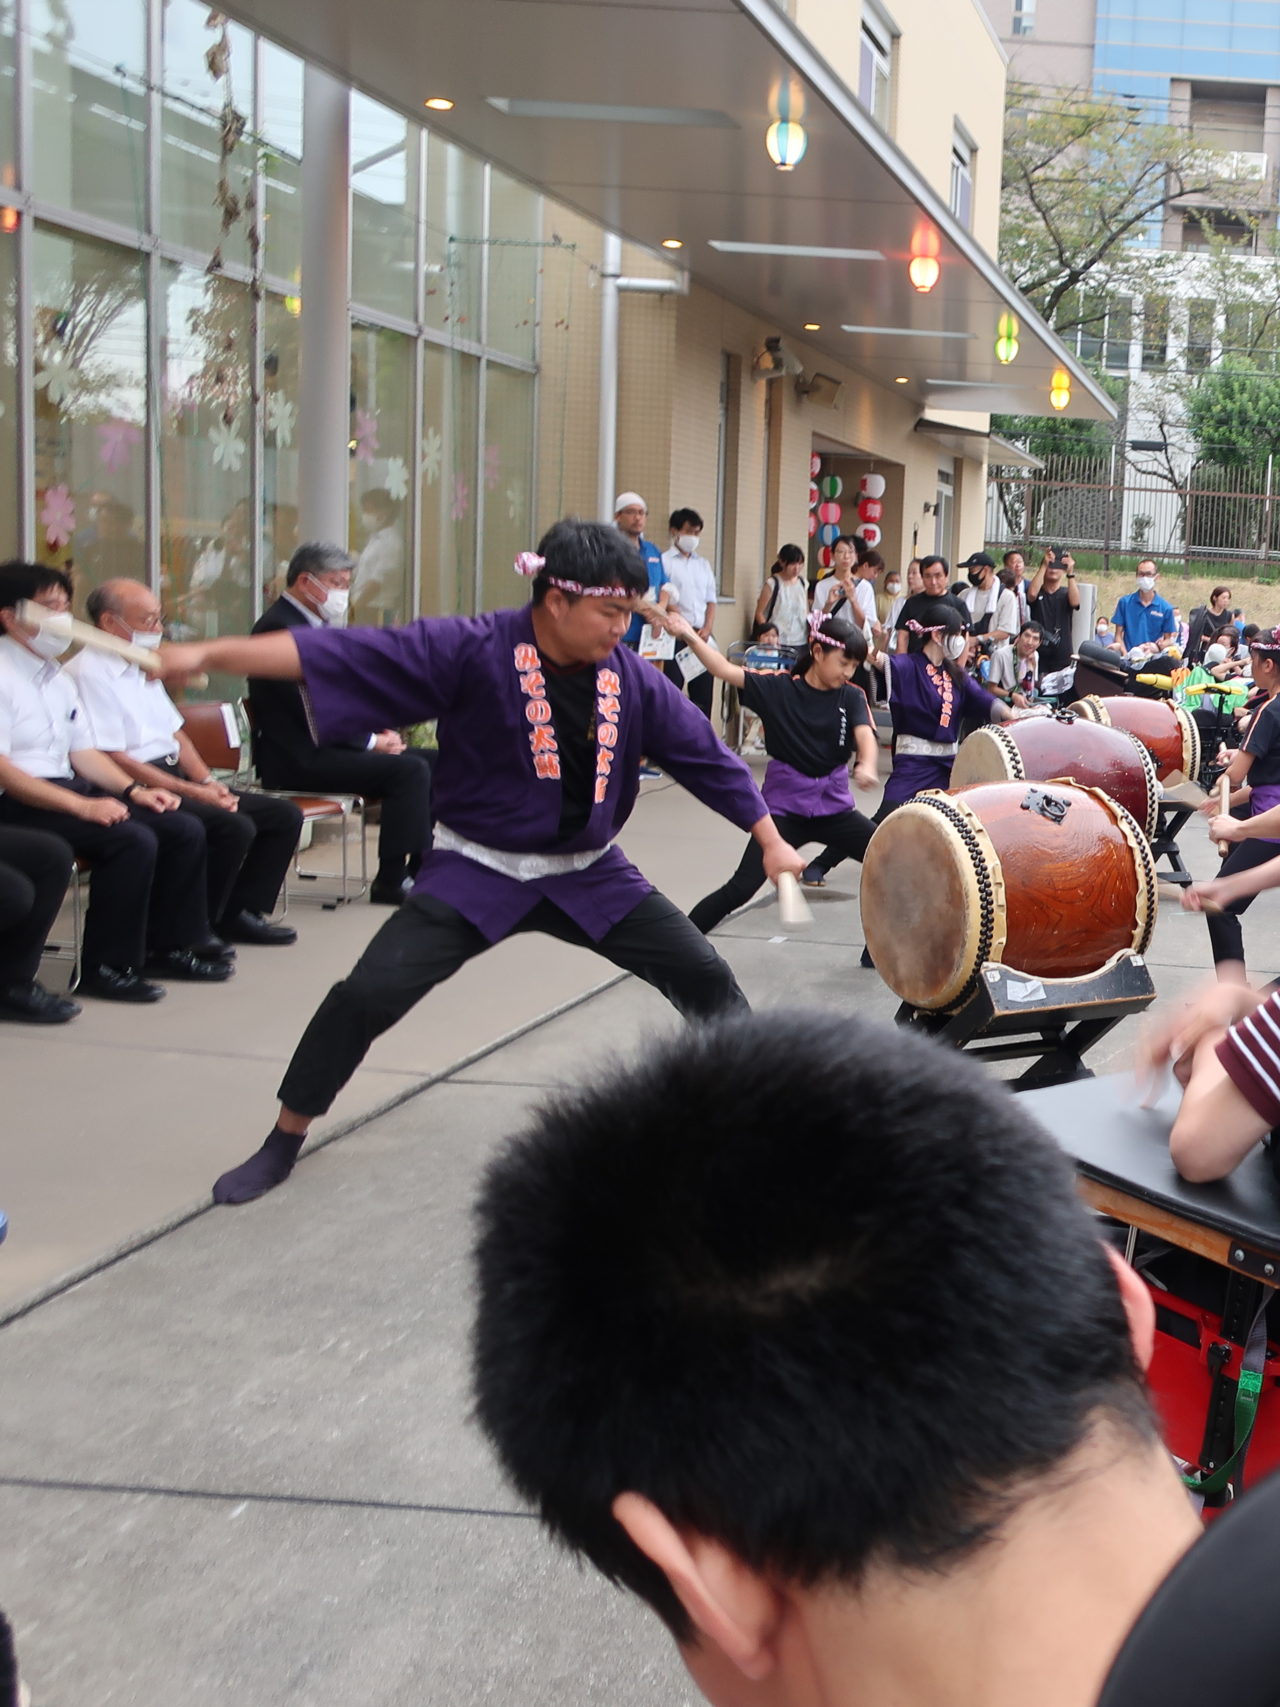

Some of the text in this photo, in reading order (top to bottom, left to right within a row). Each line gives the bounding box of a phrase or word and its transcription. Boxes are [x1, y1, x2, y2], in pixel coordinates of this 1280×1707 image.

[513, 642, 562, 780] みその太鼓
